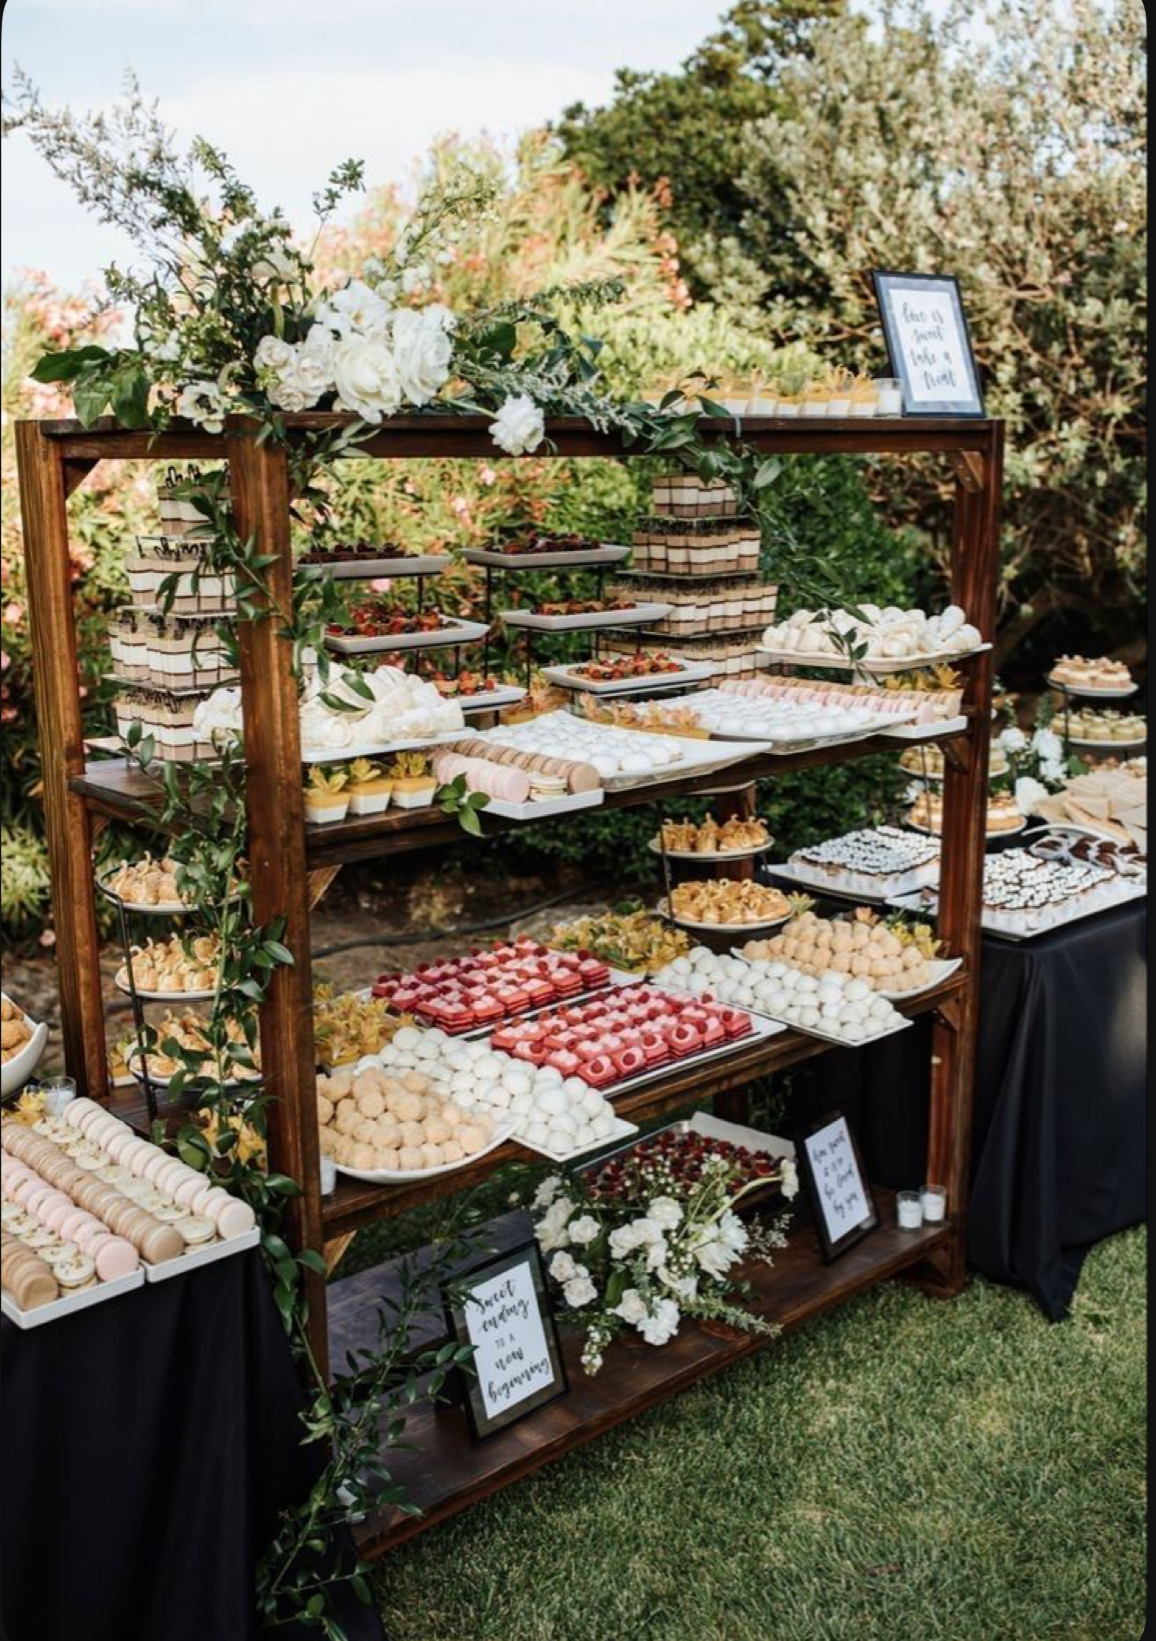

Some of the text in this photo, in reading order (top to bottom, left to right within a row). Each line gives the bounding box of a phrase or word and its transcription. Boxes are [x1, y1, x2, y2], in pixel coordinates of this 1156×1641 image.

[478, 1298, 530, 1334] ending
[494, 1347, 525, 1371] new
[486, 1356, 550, 1403] beginning
